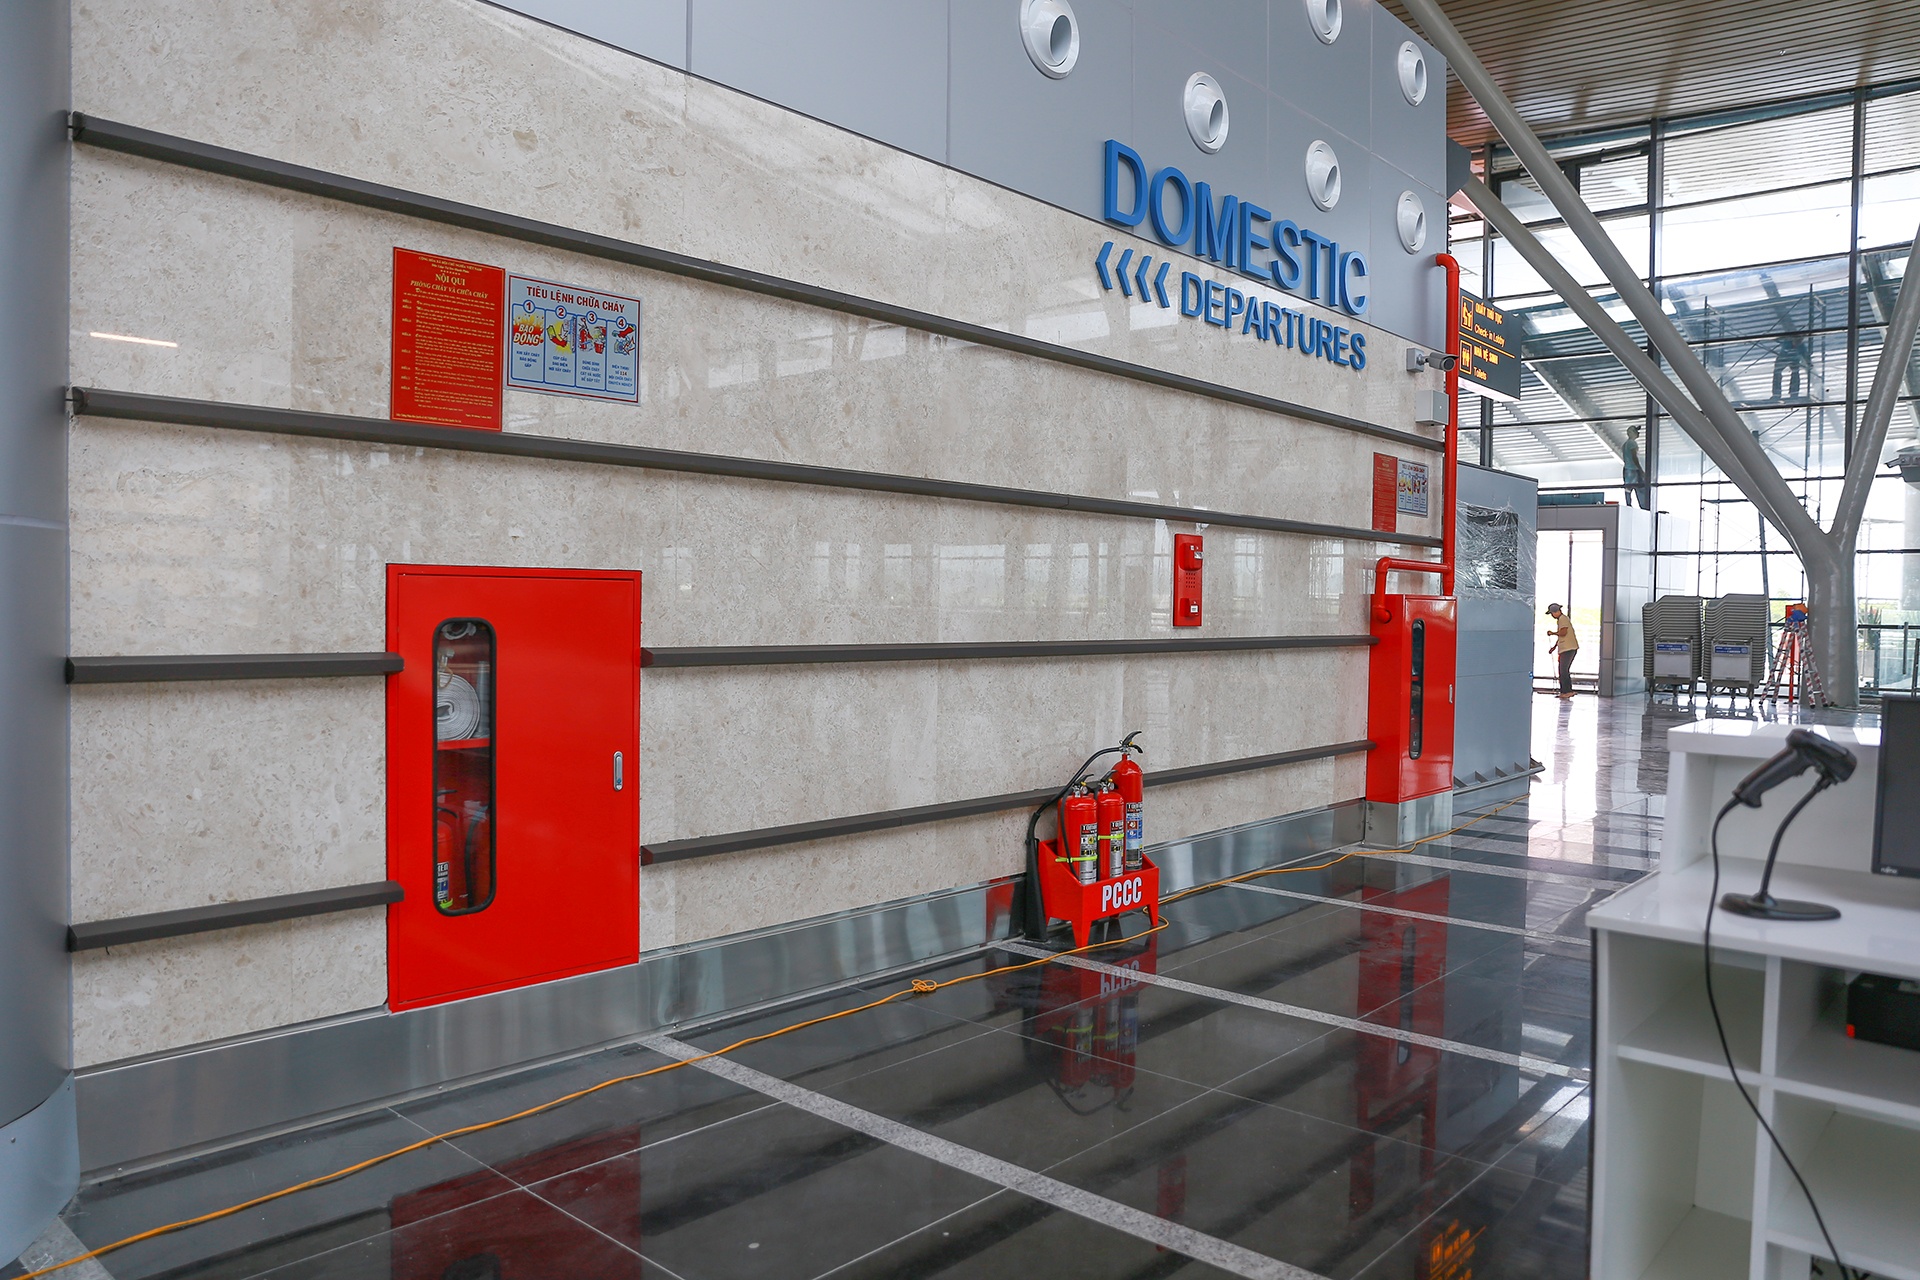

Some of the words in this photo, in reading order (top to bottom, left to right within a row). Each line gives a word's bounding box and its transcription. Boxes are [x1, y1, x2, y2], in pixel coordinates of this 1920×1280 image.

[1104, 139, 1369, 315] DOMESTIC
[435, 273, 449, 283] NỘI
[527, 286, 548, 298] TIÊU
[550, 290, 574, 303] LỆNH
[576, 296, 600, 309] CHỮA
[602, 301, 625, 313] CHÁY
[526, 302, 531, 310] 1
[559, 308, 564, 316] 2
[589, 313, 595, 321] 3
[618, 319, 624, 327] 4
[1181, 271, 1366, 370] DEPARTURES
[1102, 876, 1142, 912] PCCC
